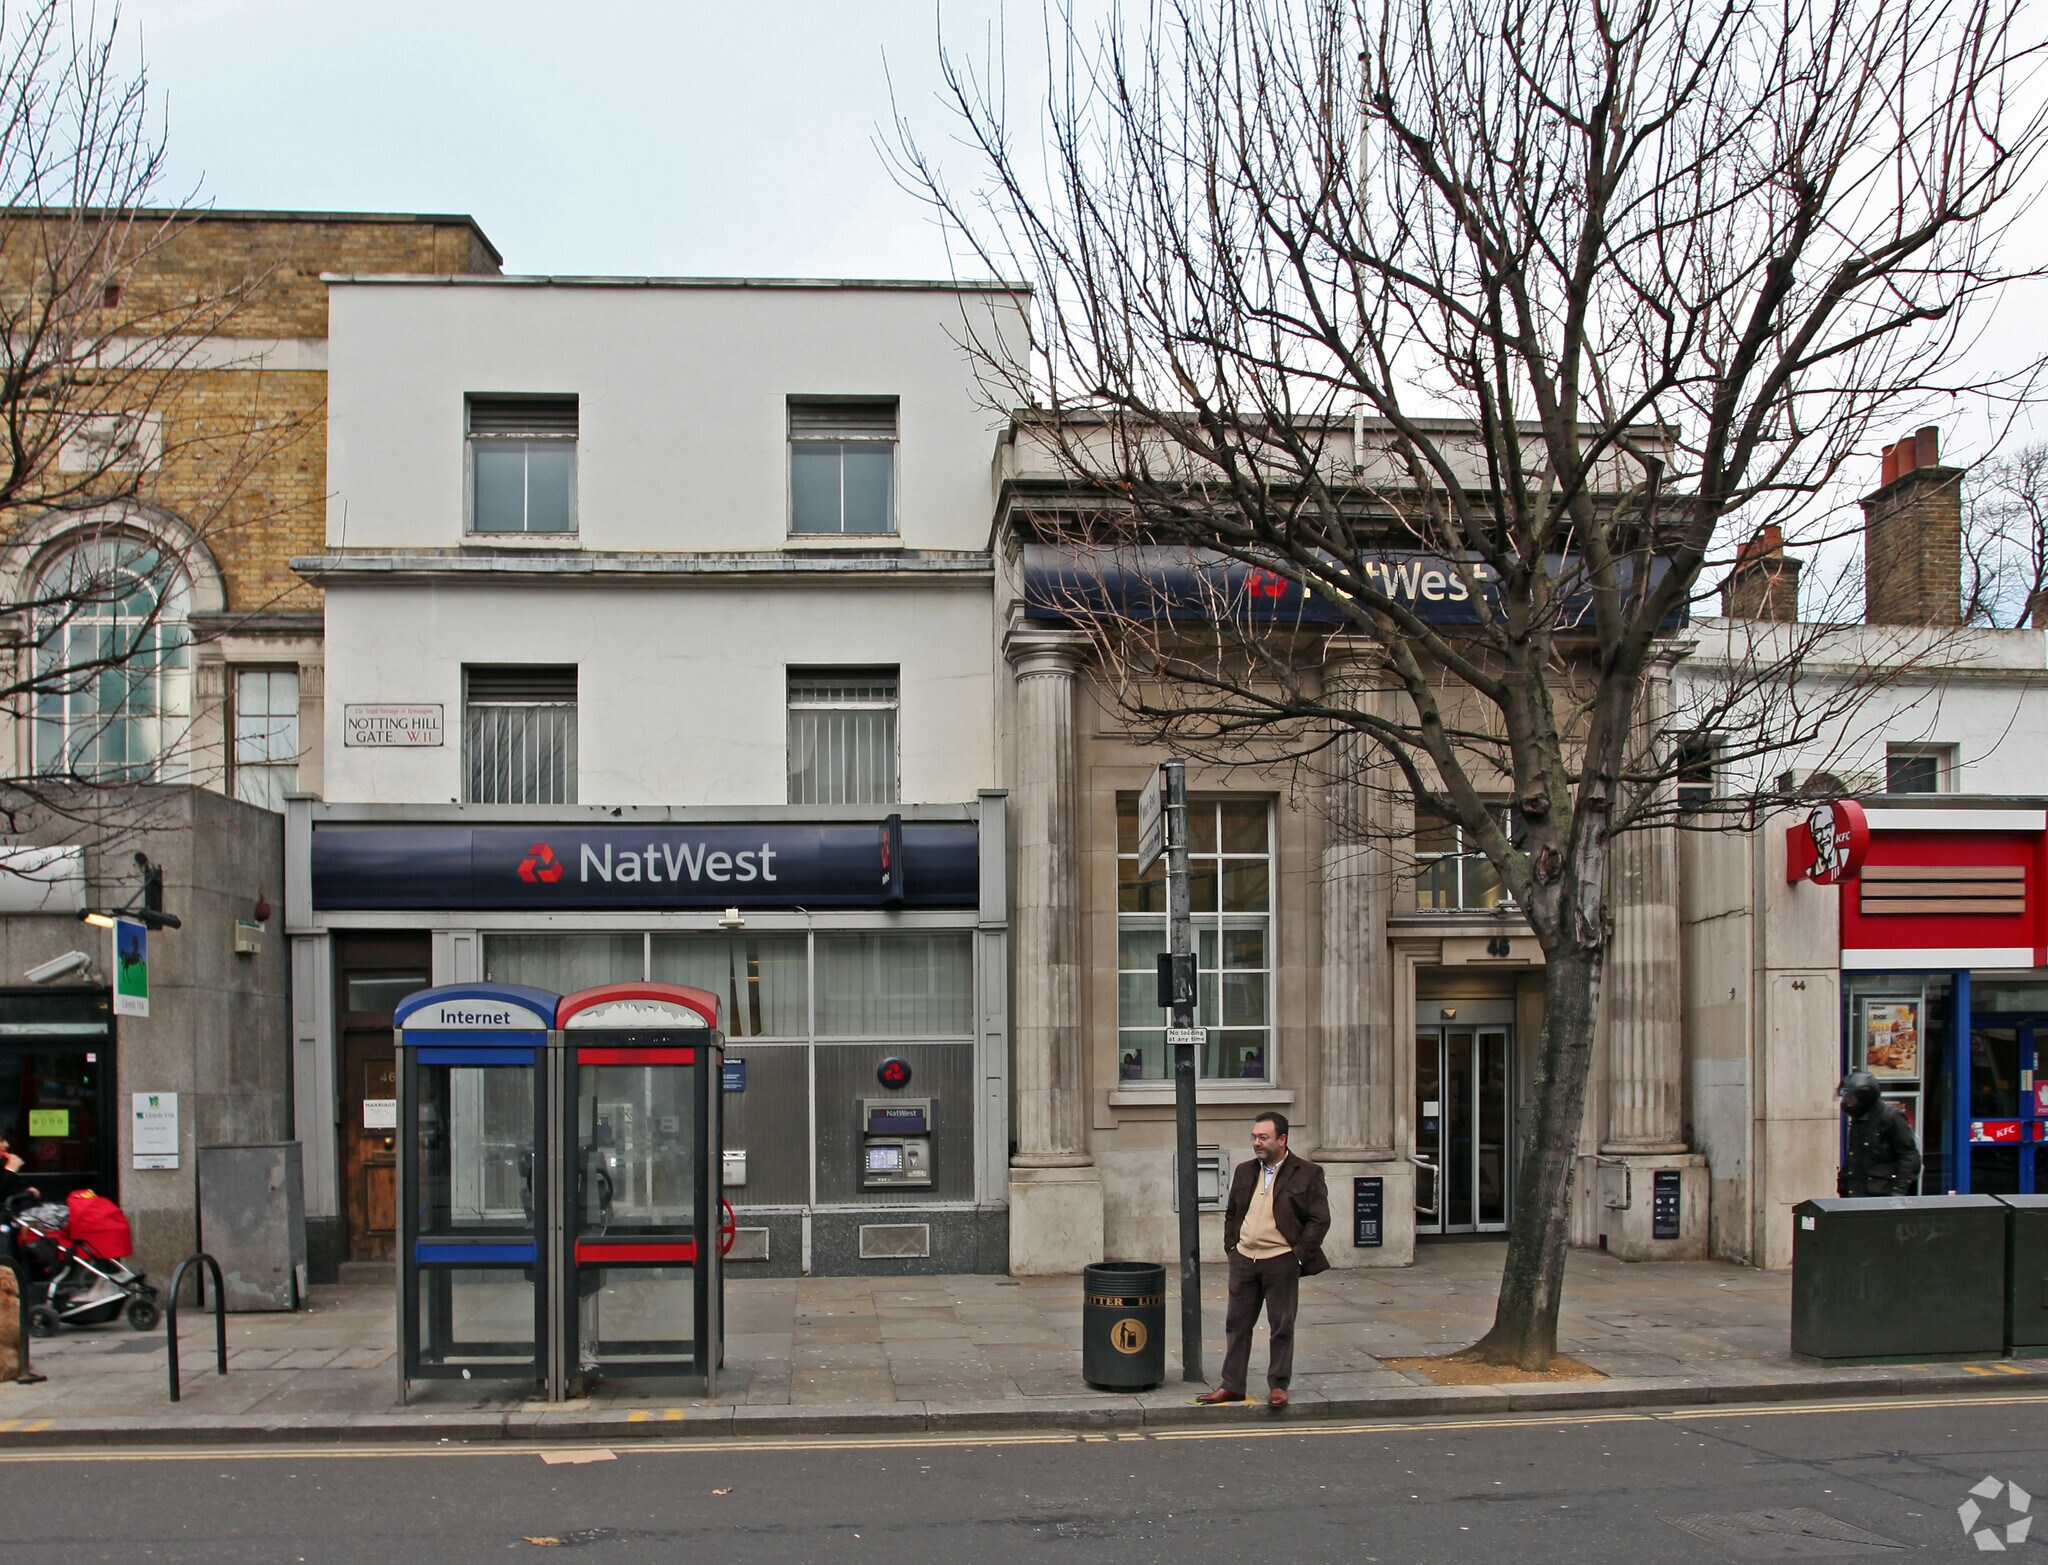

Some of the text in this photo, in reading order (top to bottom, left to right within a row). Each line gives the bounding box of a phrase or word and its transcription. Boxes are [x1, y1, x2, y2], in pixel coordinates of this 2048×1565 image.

[349, 718, 439, 729] NOTTING HILL
[1835, 831, 1851, 844] KFC
[580, 842, 777, 882] NatWest
[1791, 980, 1806, 991] 44
[440, 1008, 511, 1025] Internet
[886, 1109, 917, 1117] NatWest
[1996, 1125, 2016, 1138] KFC
